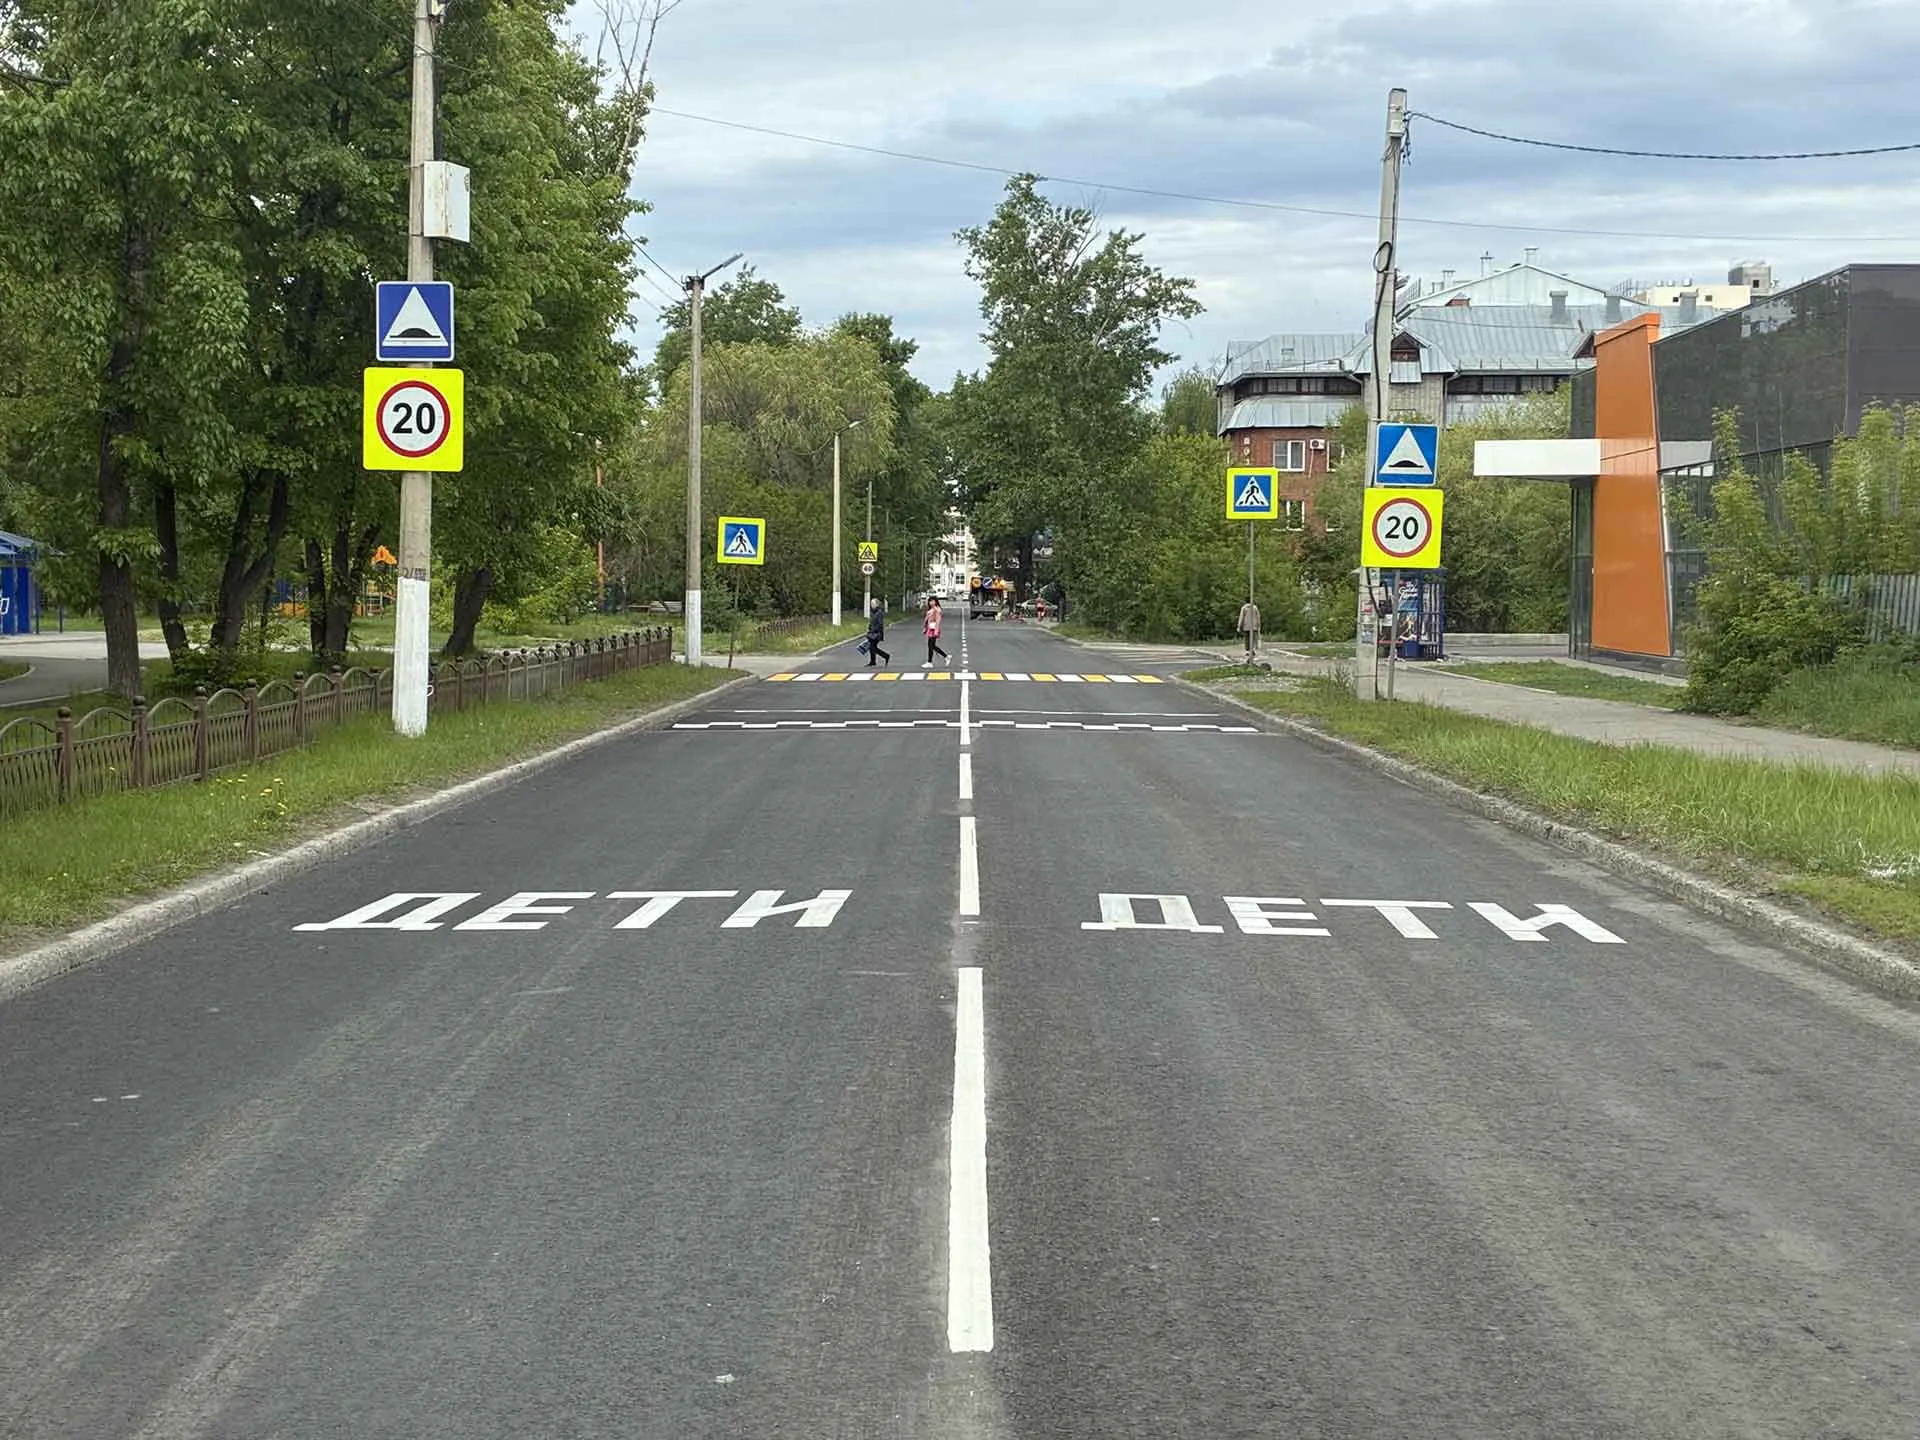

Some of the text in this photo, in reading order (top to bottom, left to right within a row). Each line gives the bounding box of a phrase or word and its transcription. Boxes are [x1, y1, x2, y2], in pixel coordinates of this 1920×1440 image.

[392, 403, 435, 434] 20
[1385, 516, 1418, 539] 20
[292, 890, 852, 931] ДЕТИ
[1081, 893, 1627, 943] ДЕТИ
